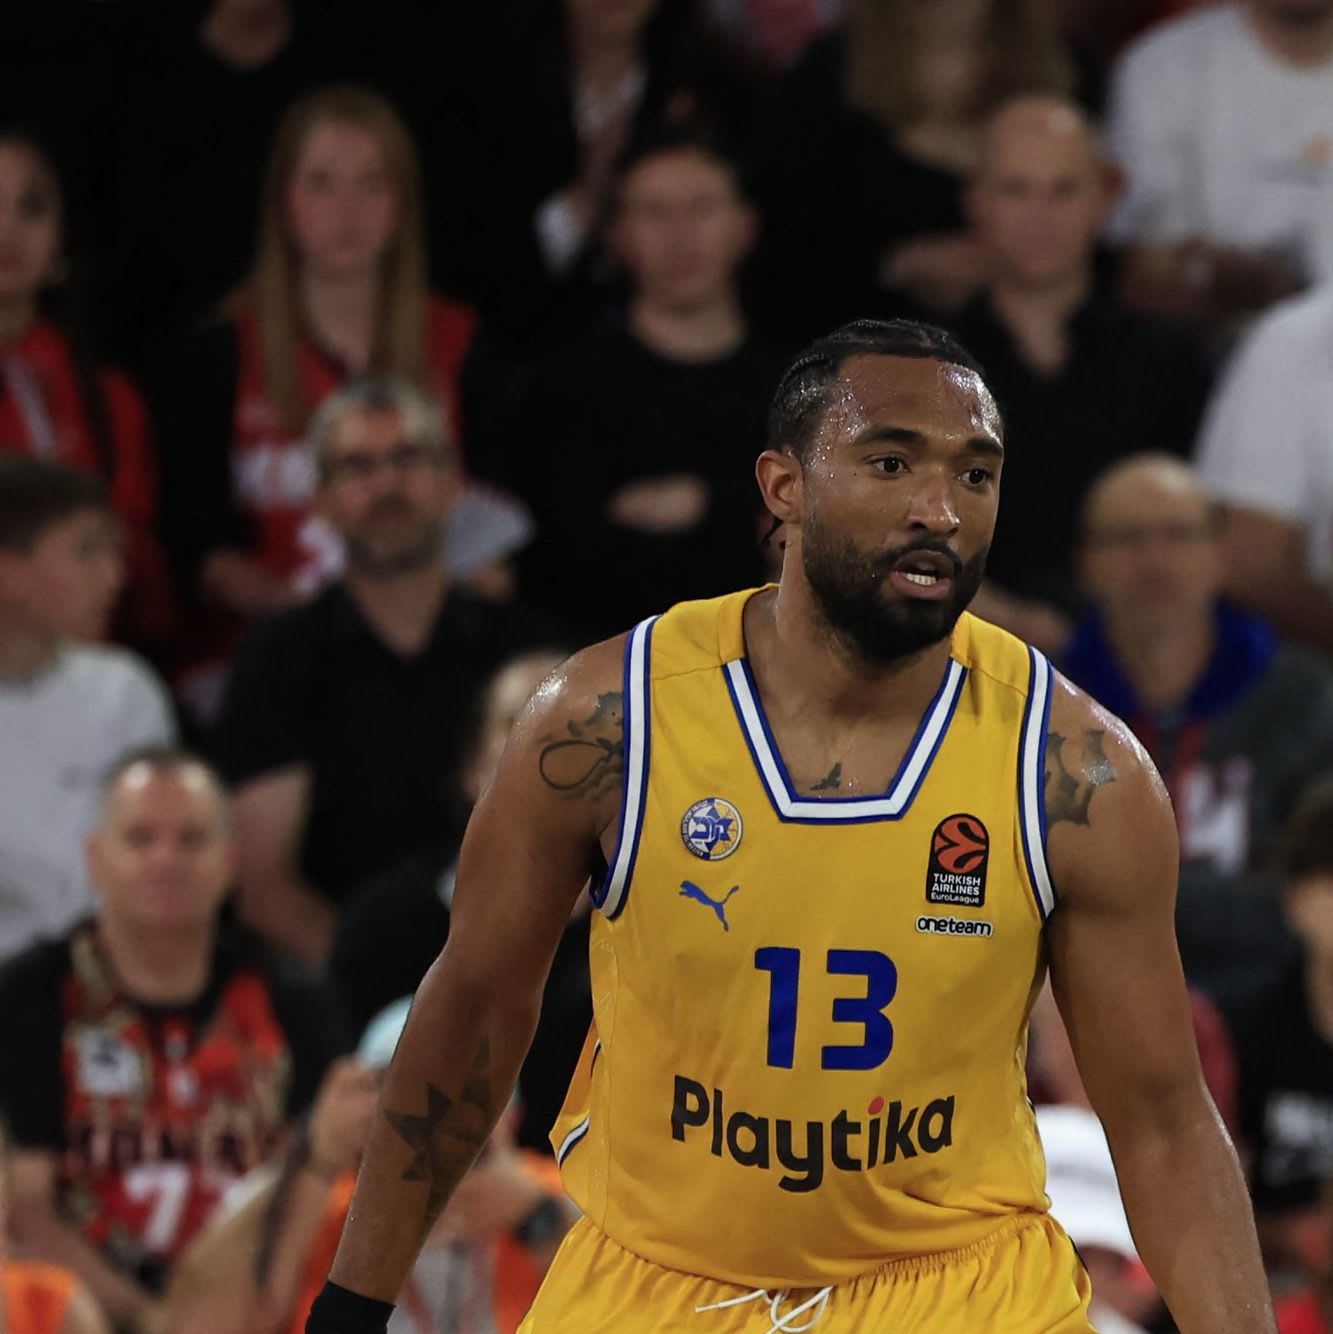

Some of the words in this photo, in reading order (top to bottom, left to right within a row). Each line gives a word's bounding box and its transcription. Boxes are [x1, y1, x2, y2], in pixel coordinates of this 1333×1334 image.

[933, 873, 981, 886] TURKISH
[932, 883, 980, 896] AIRLINES
[931, 892, 980, 905] EuroLeague
[917, 916, 992, 936] oneteam
[754, 947, 898, 1070] 13
[670, 1075, 956, 1193] Playtika
